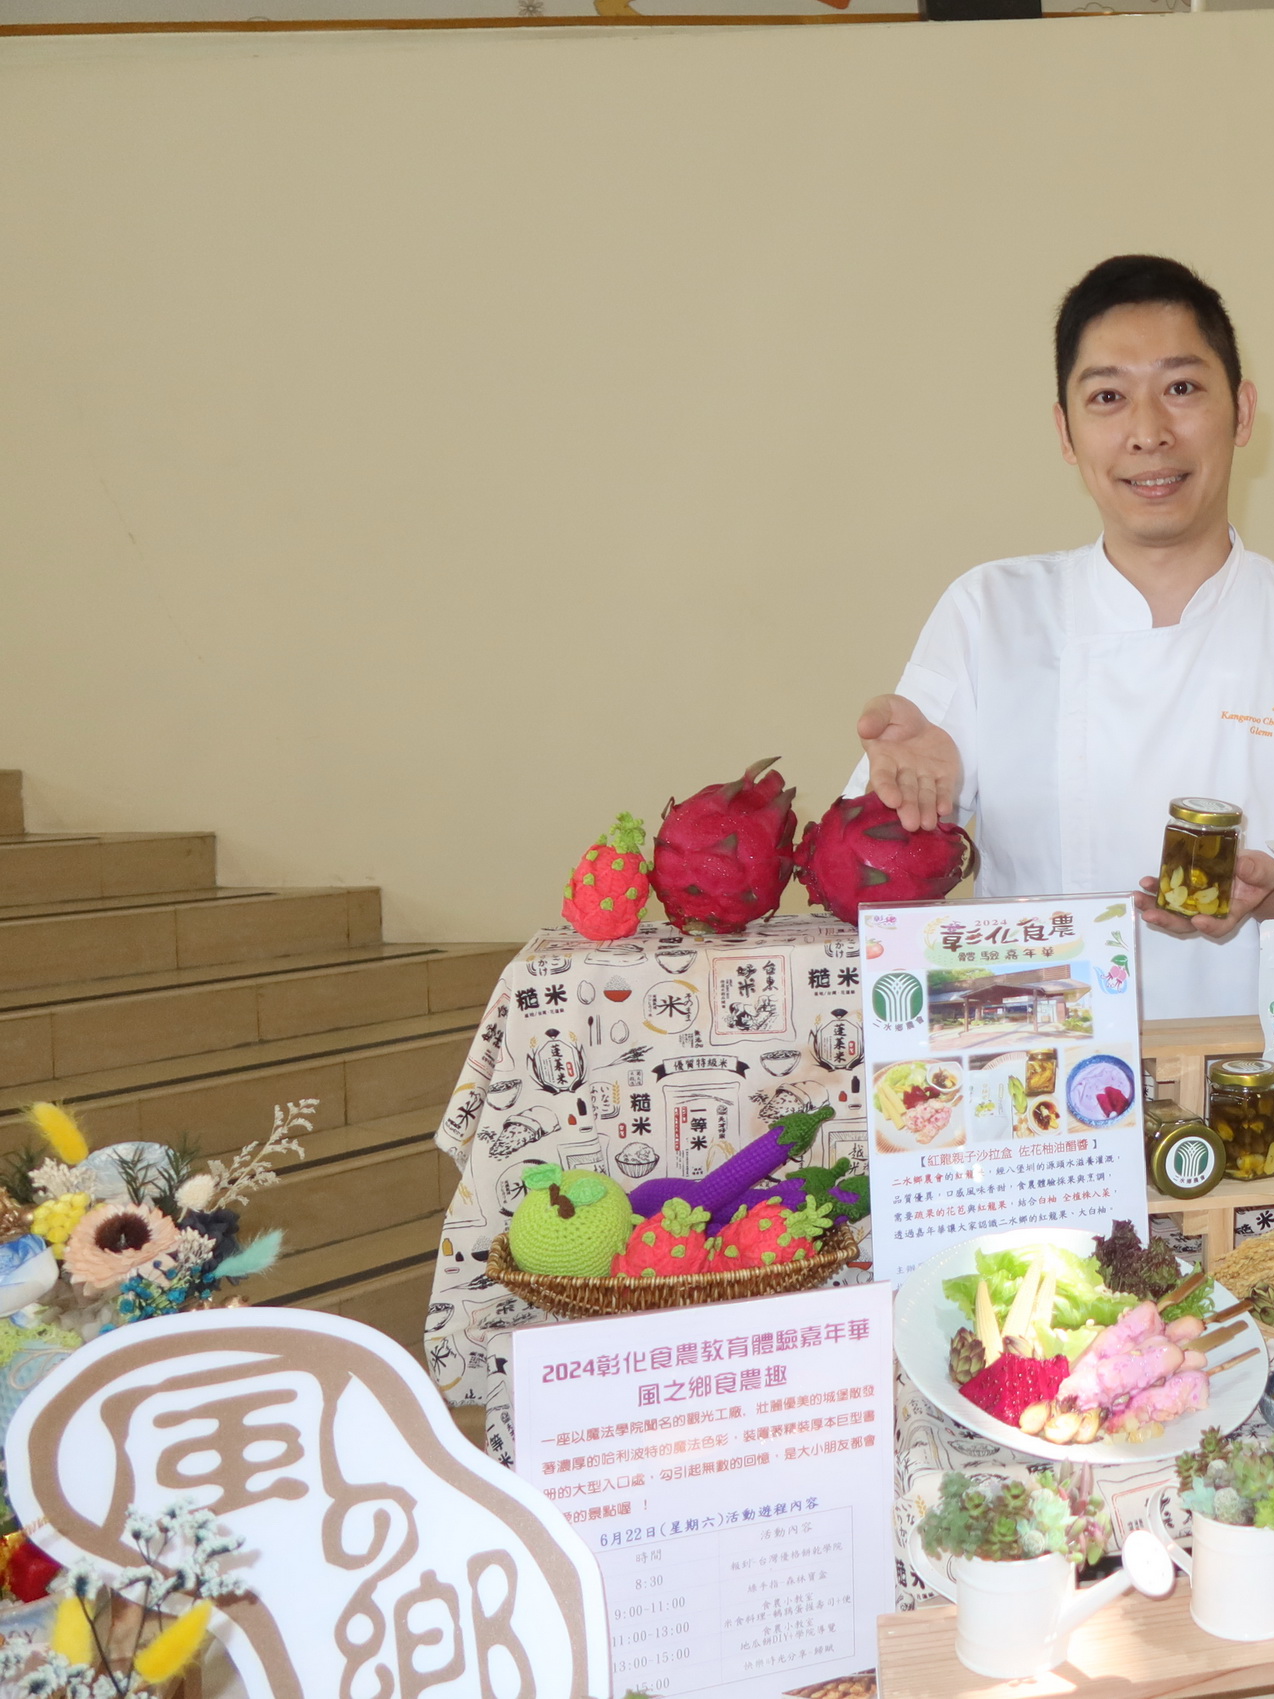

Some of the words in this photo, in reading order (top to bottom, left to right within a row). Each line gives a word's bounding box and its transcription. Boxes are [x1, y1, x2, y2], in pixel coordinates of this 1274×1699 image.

[1220, 710, 1261, 723] Kangaroo
[1249, 725, 1273, 737] Glenn
[940, 914, 1077, 952] 彰化食農
[974, 918, 1009, 928] 2024
[957, 946, 1055, 962] 體驗嘉年華
[761, 960, 779, 992] 台東
[808, 966, 861, 989] 糙米
[515, 983, 568, 1011] 糙米
[655, 995, 688, 1018] 米
[872, 1015, 925, 1033] 二水鄉農會
[832, 1023, 848, 1063] 蓬萊米
[673, 1056, 728, 1071] 優質特級米
[630, 1092, 652, 1136] 糙米
[690, 1107, 708, 1151] 一等米
[542, 1318, 870, 1384] 2024彰化食農教育體驗嘉年華
[638, 1364, 788, 1408] 風之鄉食農趣
[600, 1496, 820, 1547] 6月22日(星期六)活動遊程內容
[760, 1521, 813, 1541] 活動內容
[635, 1548, 662, 1564] 時間
[635, 1574, 664, 1591] 8:30
[614, 1596, 686, 1621] 9:00-11:00
[612, 1621, 690, 1648] 11:00-13:00
